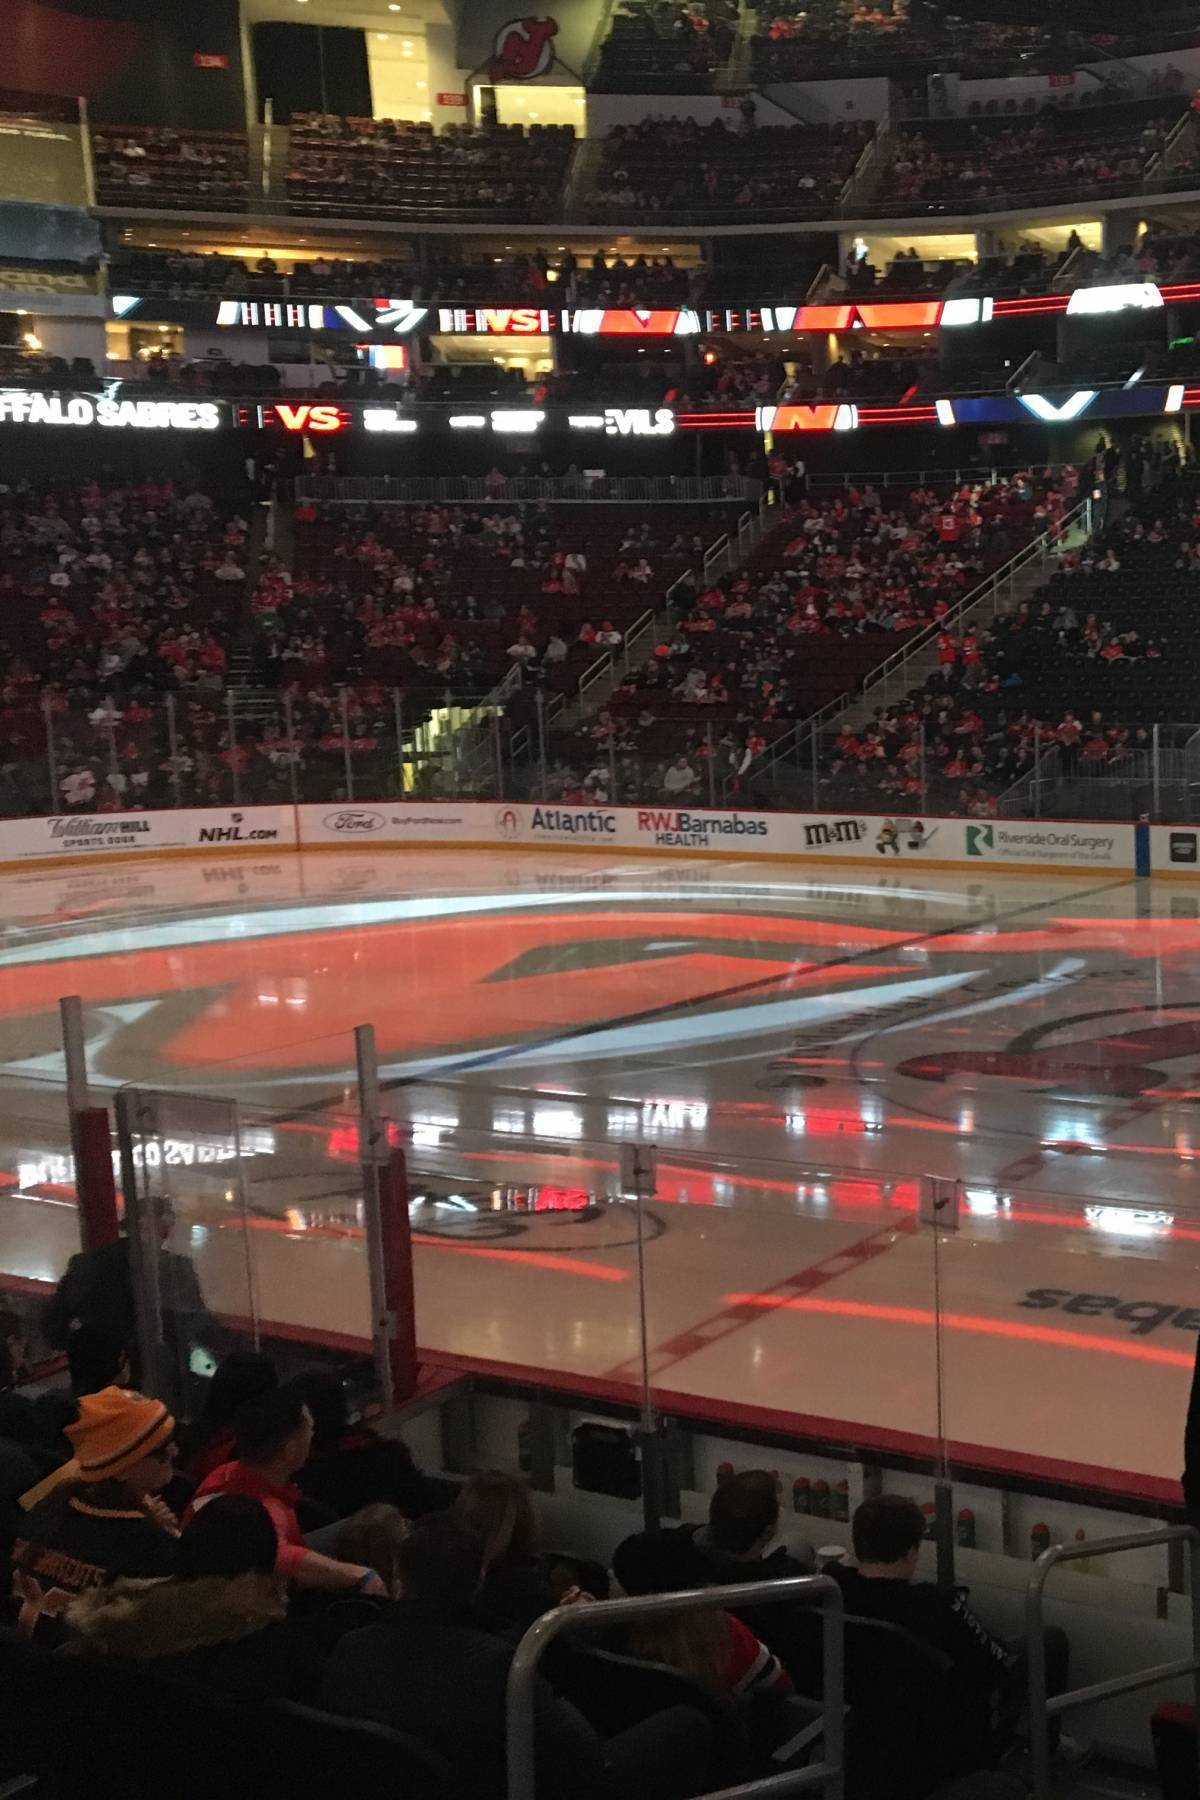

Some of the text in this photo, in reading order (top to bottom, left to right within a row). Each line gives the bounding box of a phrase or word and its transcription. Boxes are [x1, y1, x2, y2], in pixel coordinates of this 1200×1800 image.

[483, 308, 542, 334] VS
[96, 400, 220, 430] SABRES
[274, 404, 342, 432] VS
[334, 813, 375, 830] Ford
[531, 807, 617, 834] Atlantic
[637, 811, 768, 836] RWJBarnabas
[655, 832, 710, 846] HEALTH
[998, 831, 1115, 850] Riverside Oral Surgery
